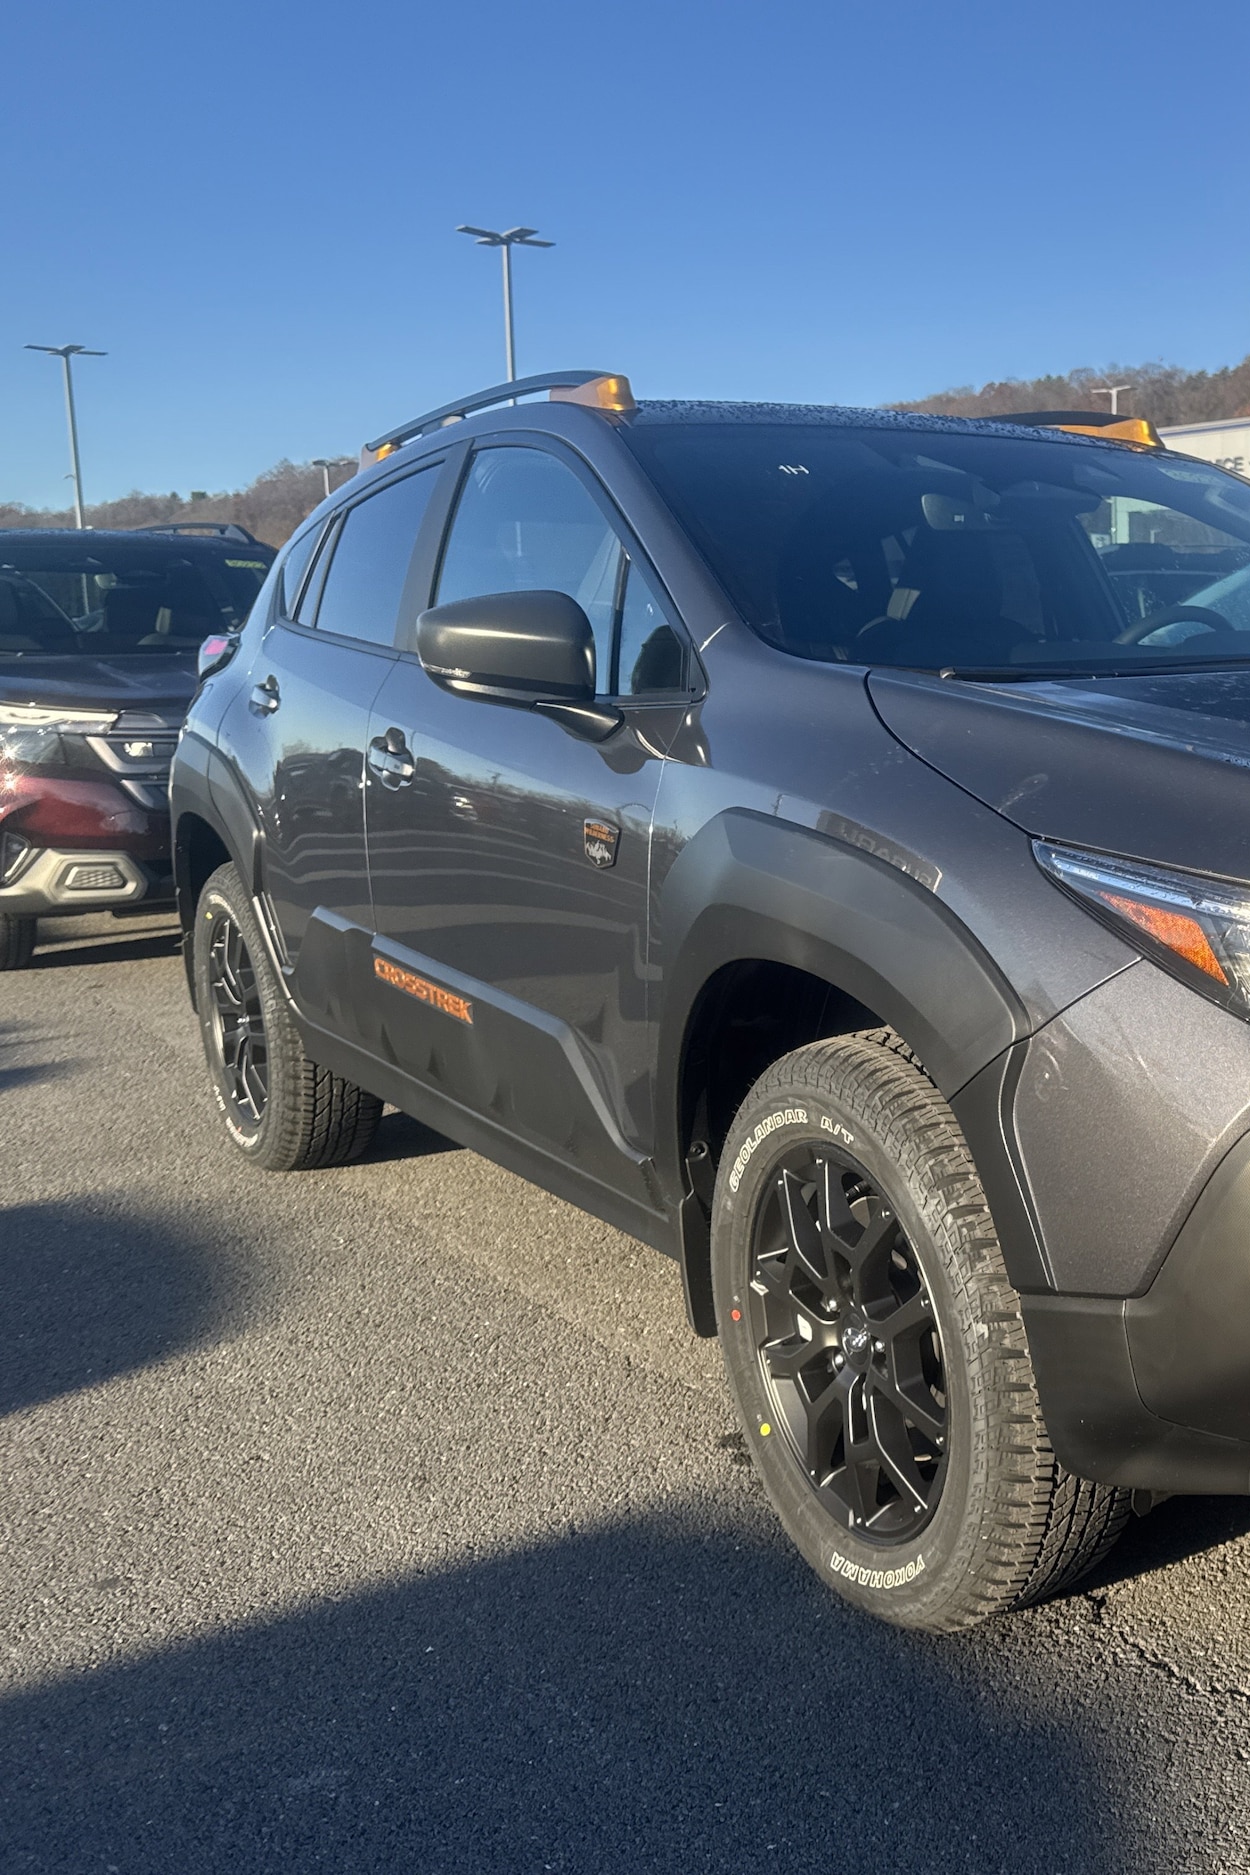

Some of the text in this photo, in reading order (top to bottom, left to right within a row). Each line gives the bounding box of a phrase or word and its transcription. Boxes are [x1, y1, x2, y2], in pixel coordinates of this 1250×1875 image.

[374, 957, 474, 1025] CROSSTREK
[728, 1108, 854, 1193] GEOLANDAR A/T
[830, 1551, 926, 1590] YOKOHAMA
